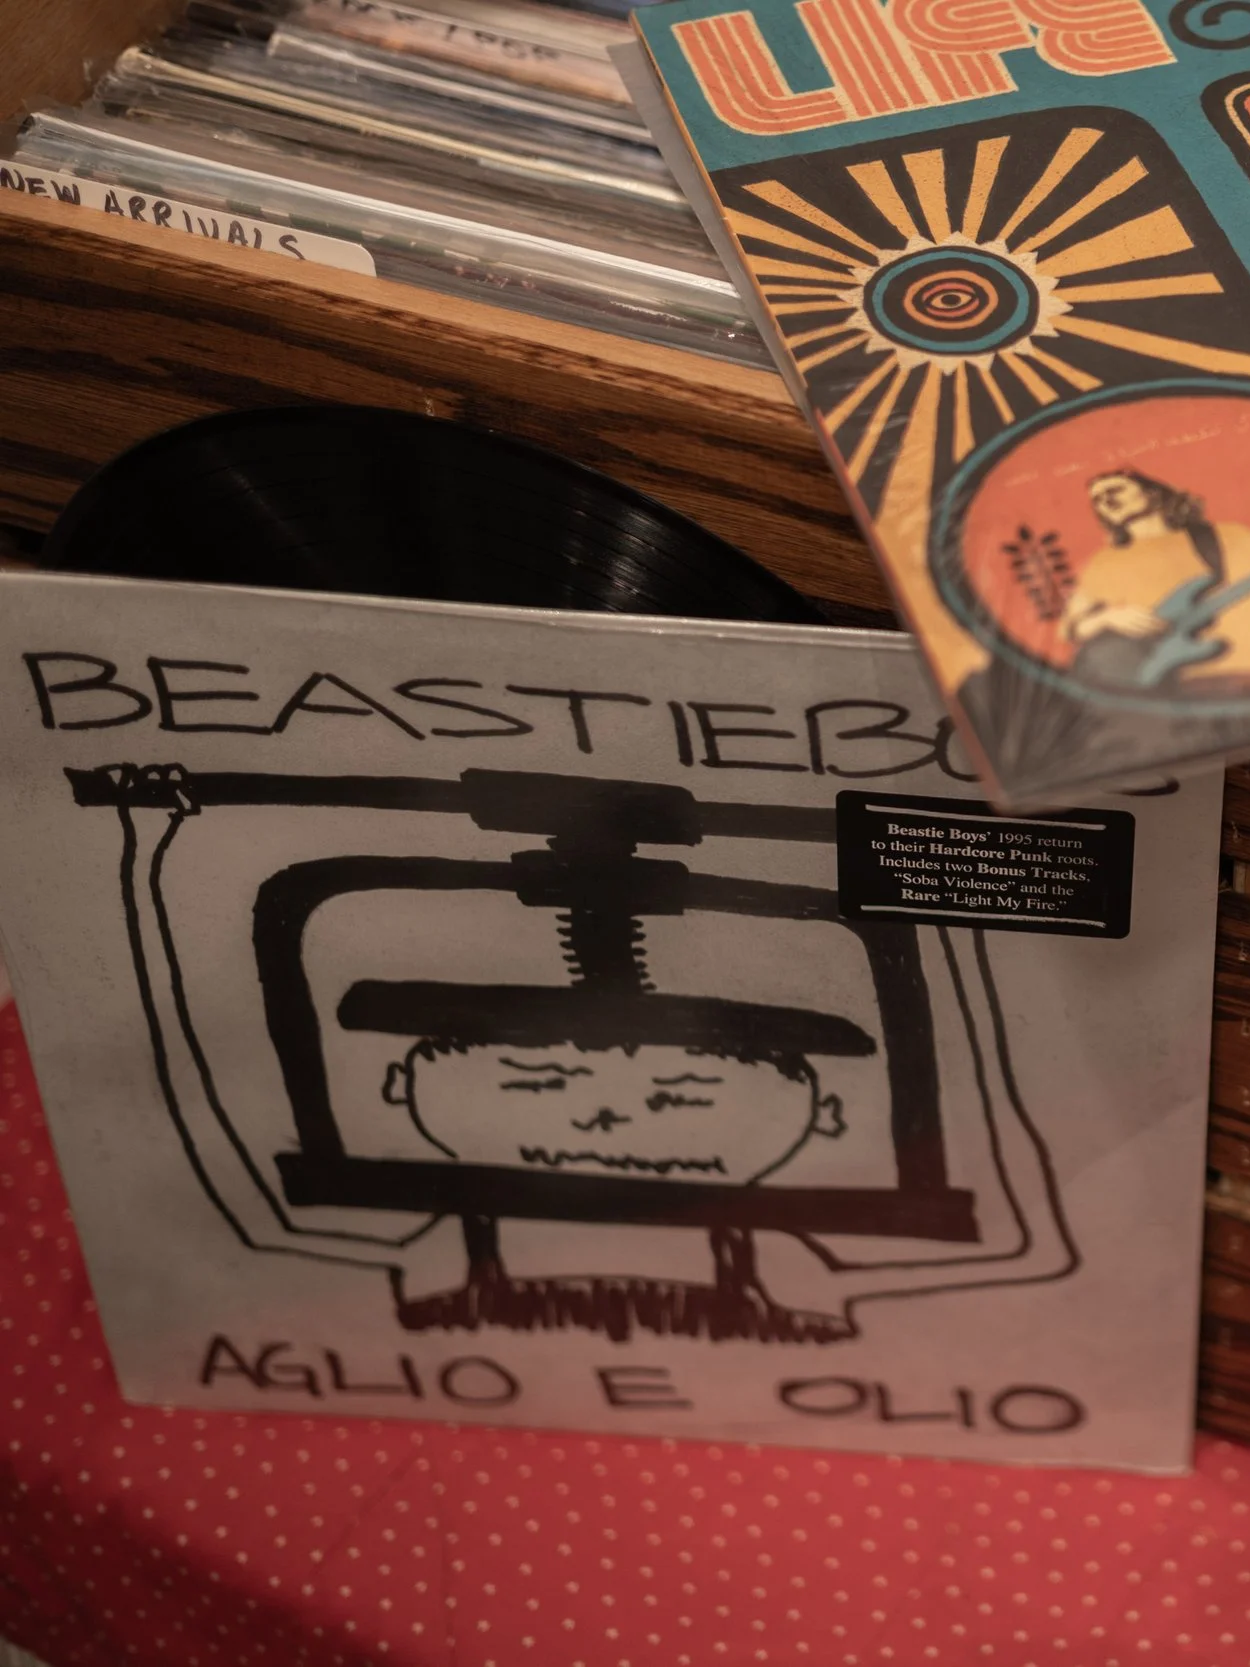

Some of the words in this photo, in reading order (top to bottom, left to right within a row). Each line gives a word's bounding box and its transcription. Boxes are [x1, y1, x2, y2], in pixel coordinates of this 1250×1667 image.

[0, 167, 81, 205] NEW
[887, 823, 945, 839] Beastie
[998, 831, 1033, 845] 1995
[1037, 836, 1083, 849] return
[871, 840, 886, 851] to
[890, 840, 926, 853] their
[929, 843, 1005, 860] Hardcore
[1009, 849, 1052, 863] Punk
[1057, 854, 1099, 867] roots.
[879, 854, 941, 871] Includes
[945, 861, 973, 873] two
[977, 862, 1027, 878] Bonus
[901, 888, 941, 902] Rare
[996, 896, 1022, 911] My
[1020, 882, 1048, 894] and
[1052, 884, 1075, 896] the
[200, 1333, 520, 1405] AGLIO
[594, 1366, 695, 1411] E
[777, 1374, 1088, 1435] OLIO
